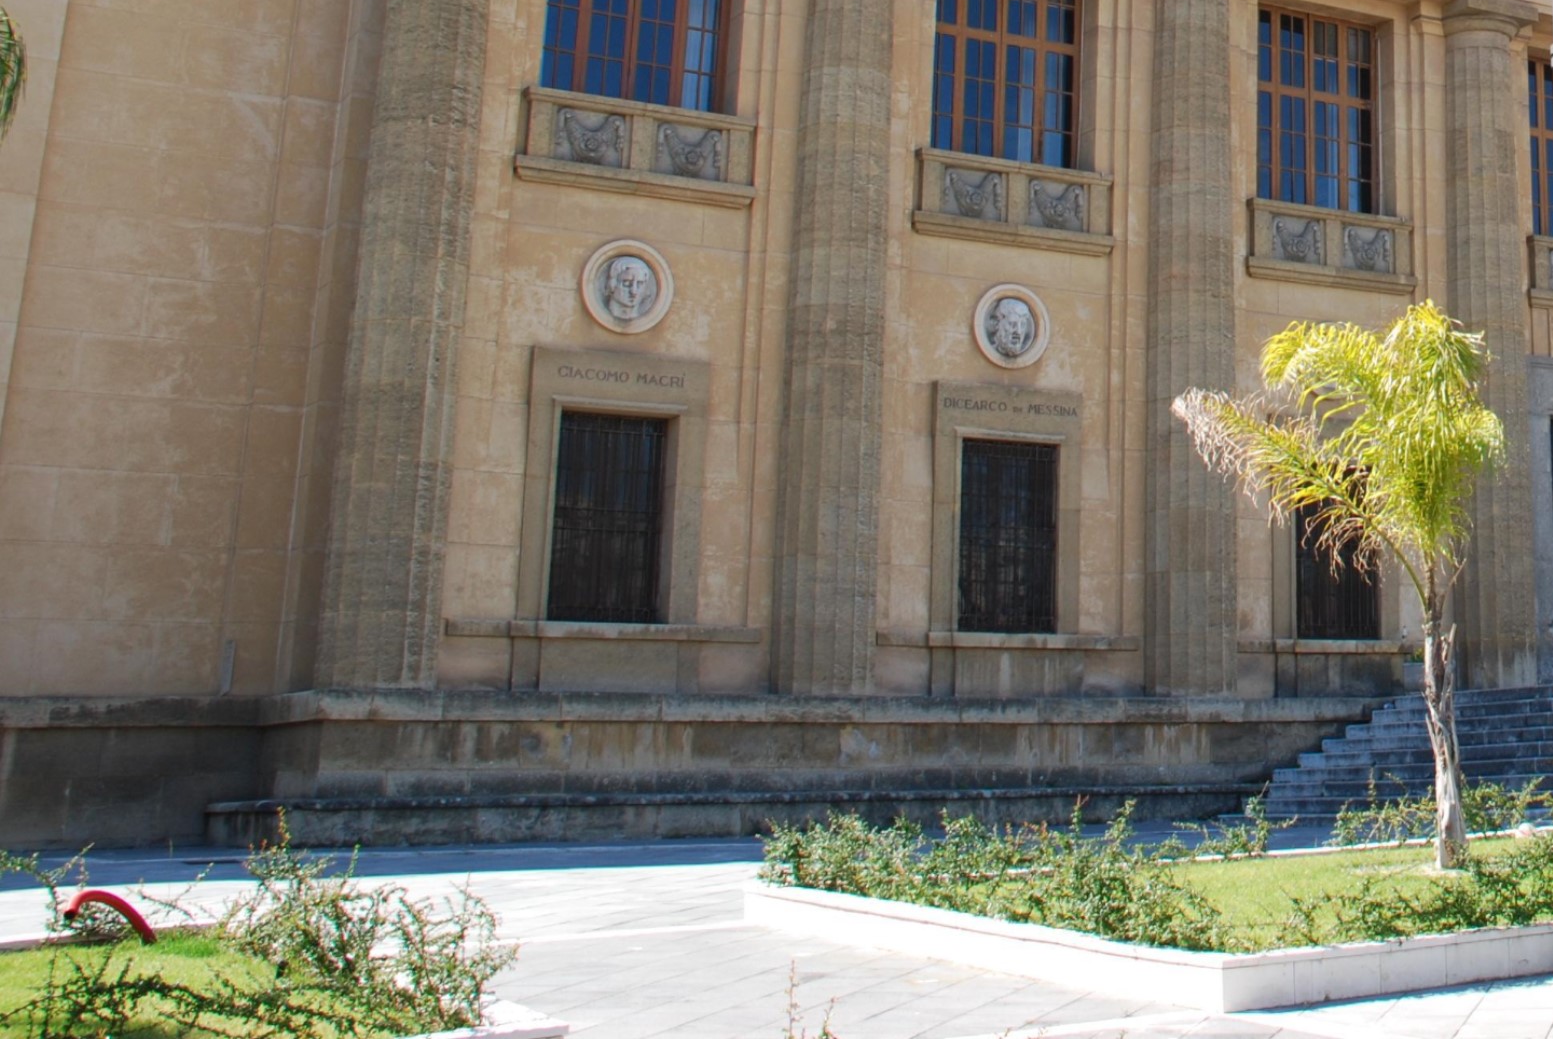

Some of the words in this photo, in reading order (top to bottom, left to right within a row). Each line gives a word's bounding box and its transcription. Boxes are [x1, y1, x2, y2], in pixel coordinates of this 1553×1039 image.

[557, 365, 630, 384] GIACOMO
[942, 396, 1008, 413] DICEARCO
[1026, 402, 1078, 418] MESSINA
